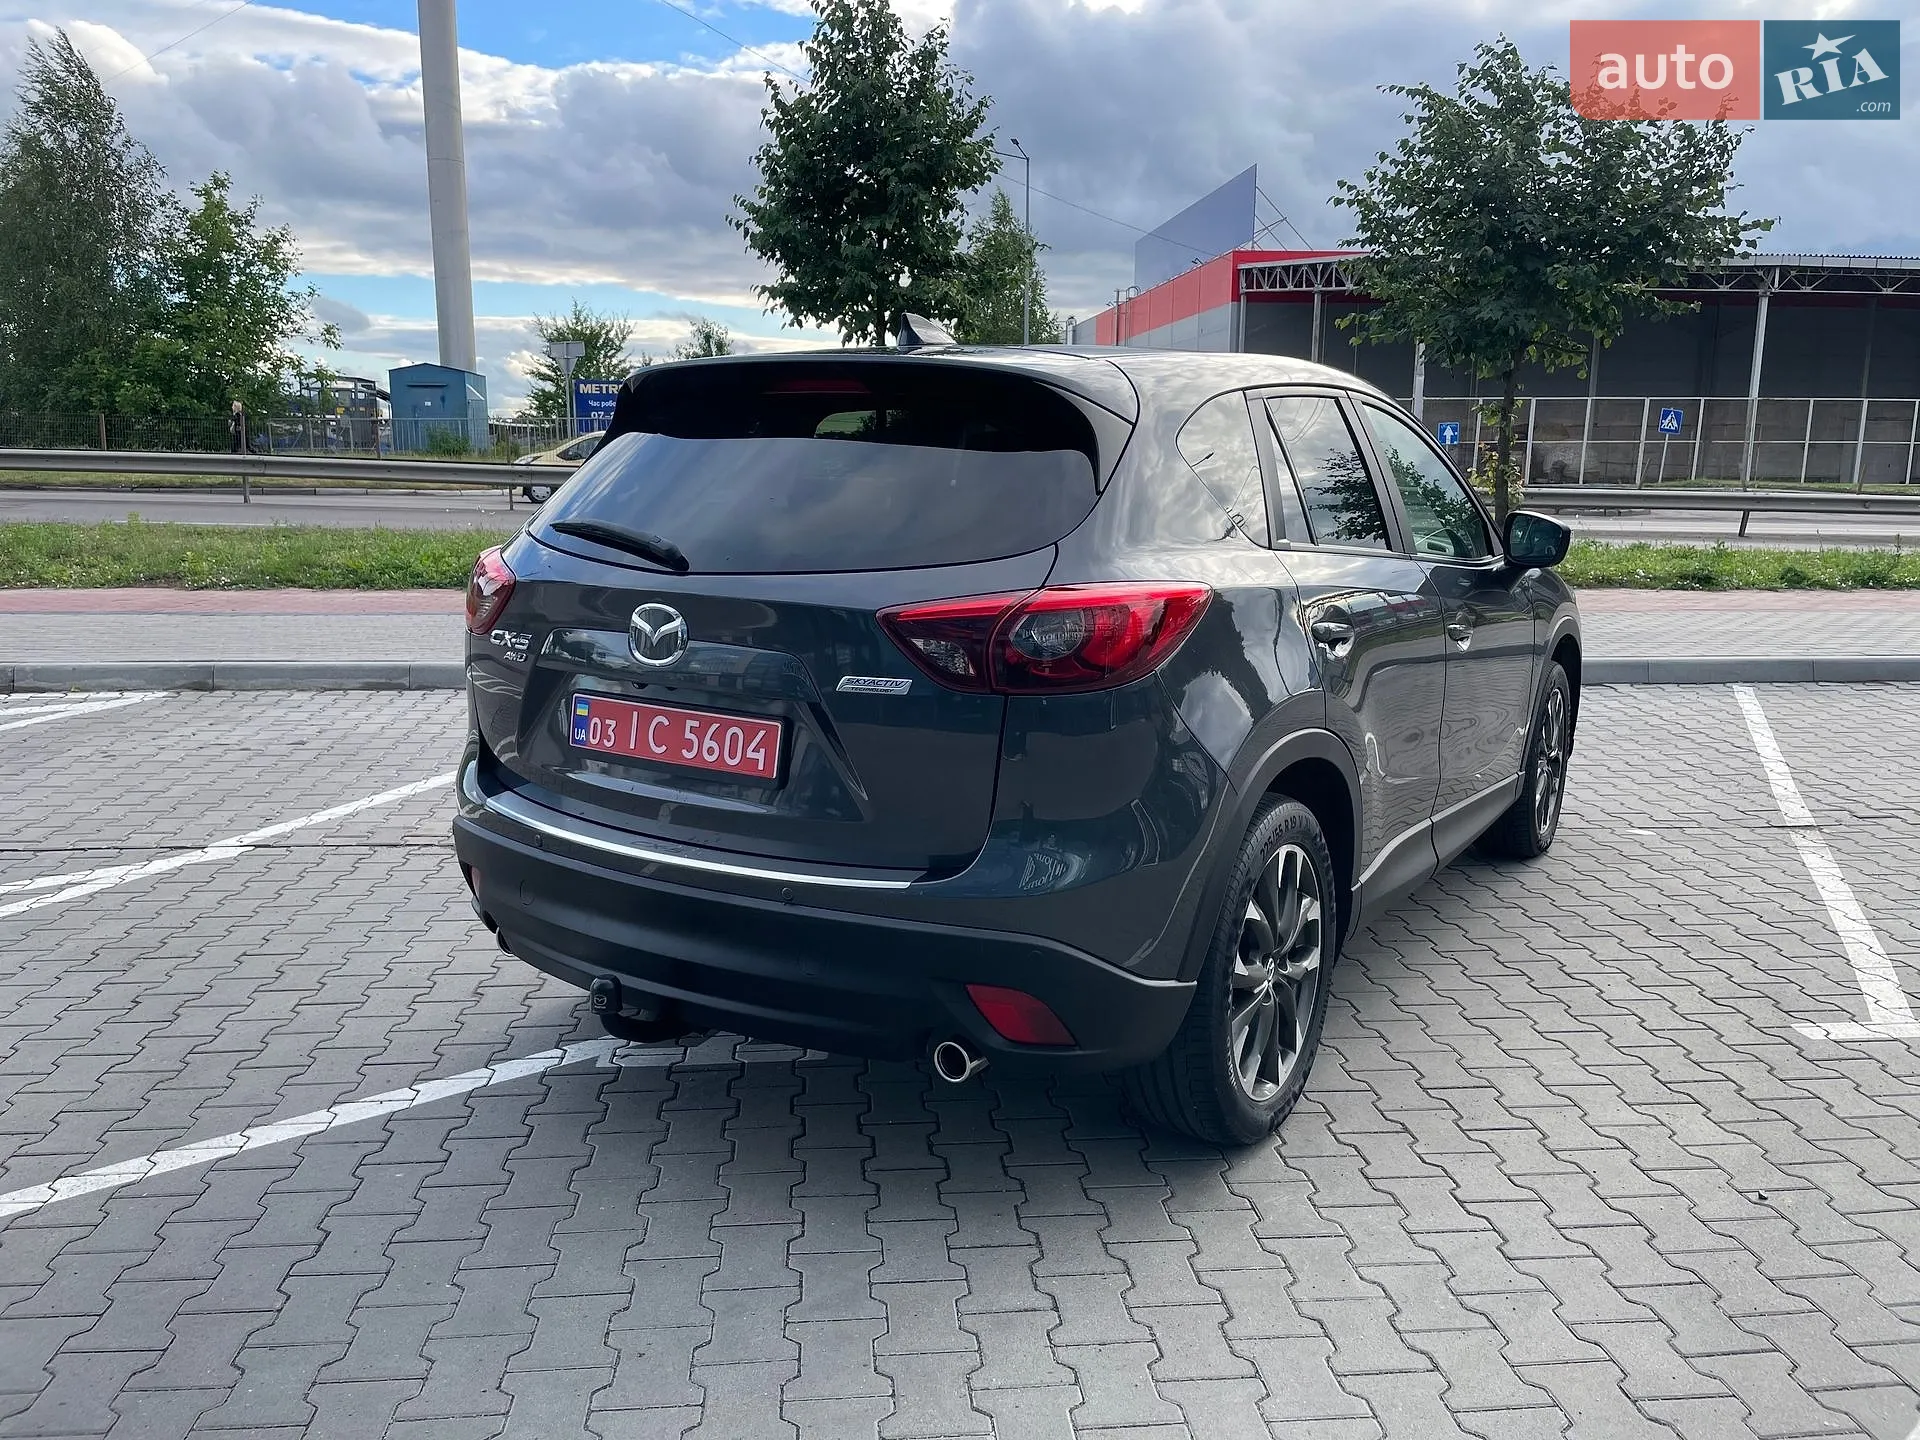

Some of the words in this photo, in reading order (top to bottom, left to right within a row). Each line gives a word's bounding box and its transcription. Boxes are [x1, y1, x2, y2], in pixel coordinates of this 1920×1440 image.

[579, 383, 622, 394] METR
[490, 629, 533, 650] CX-5
[842, 679, 907, 689] SKYACTIV
[574, 727, 586, 741] UA
[589, 717, 617, 748] 03
[681, 719, 767, 771] 5604
